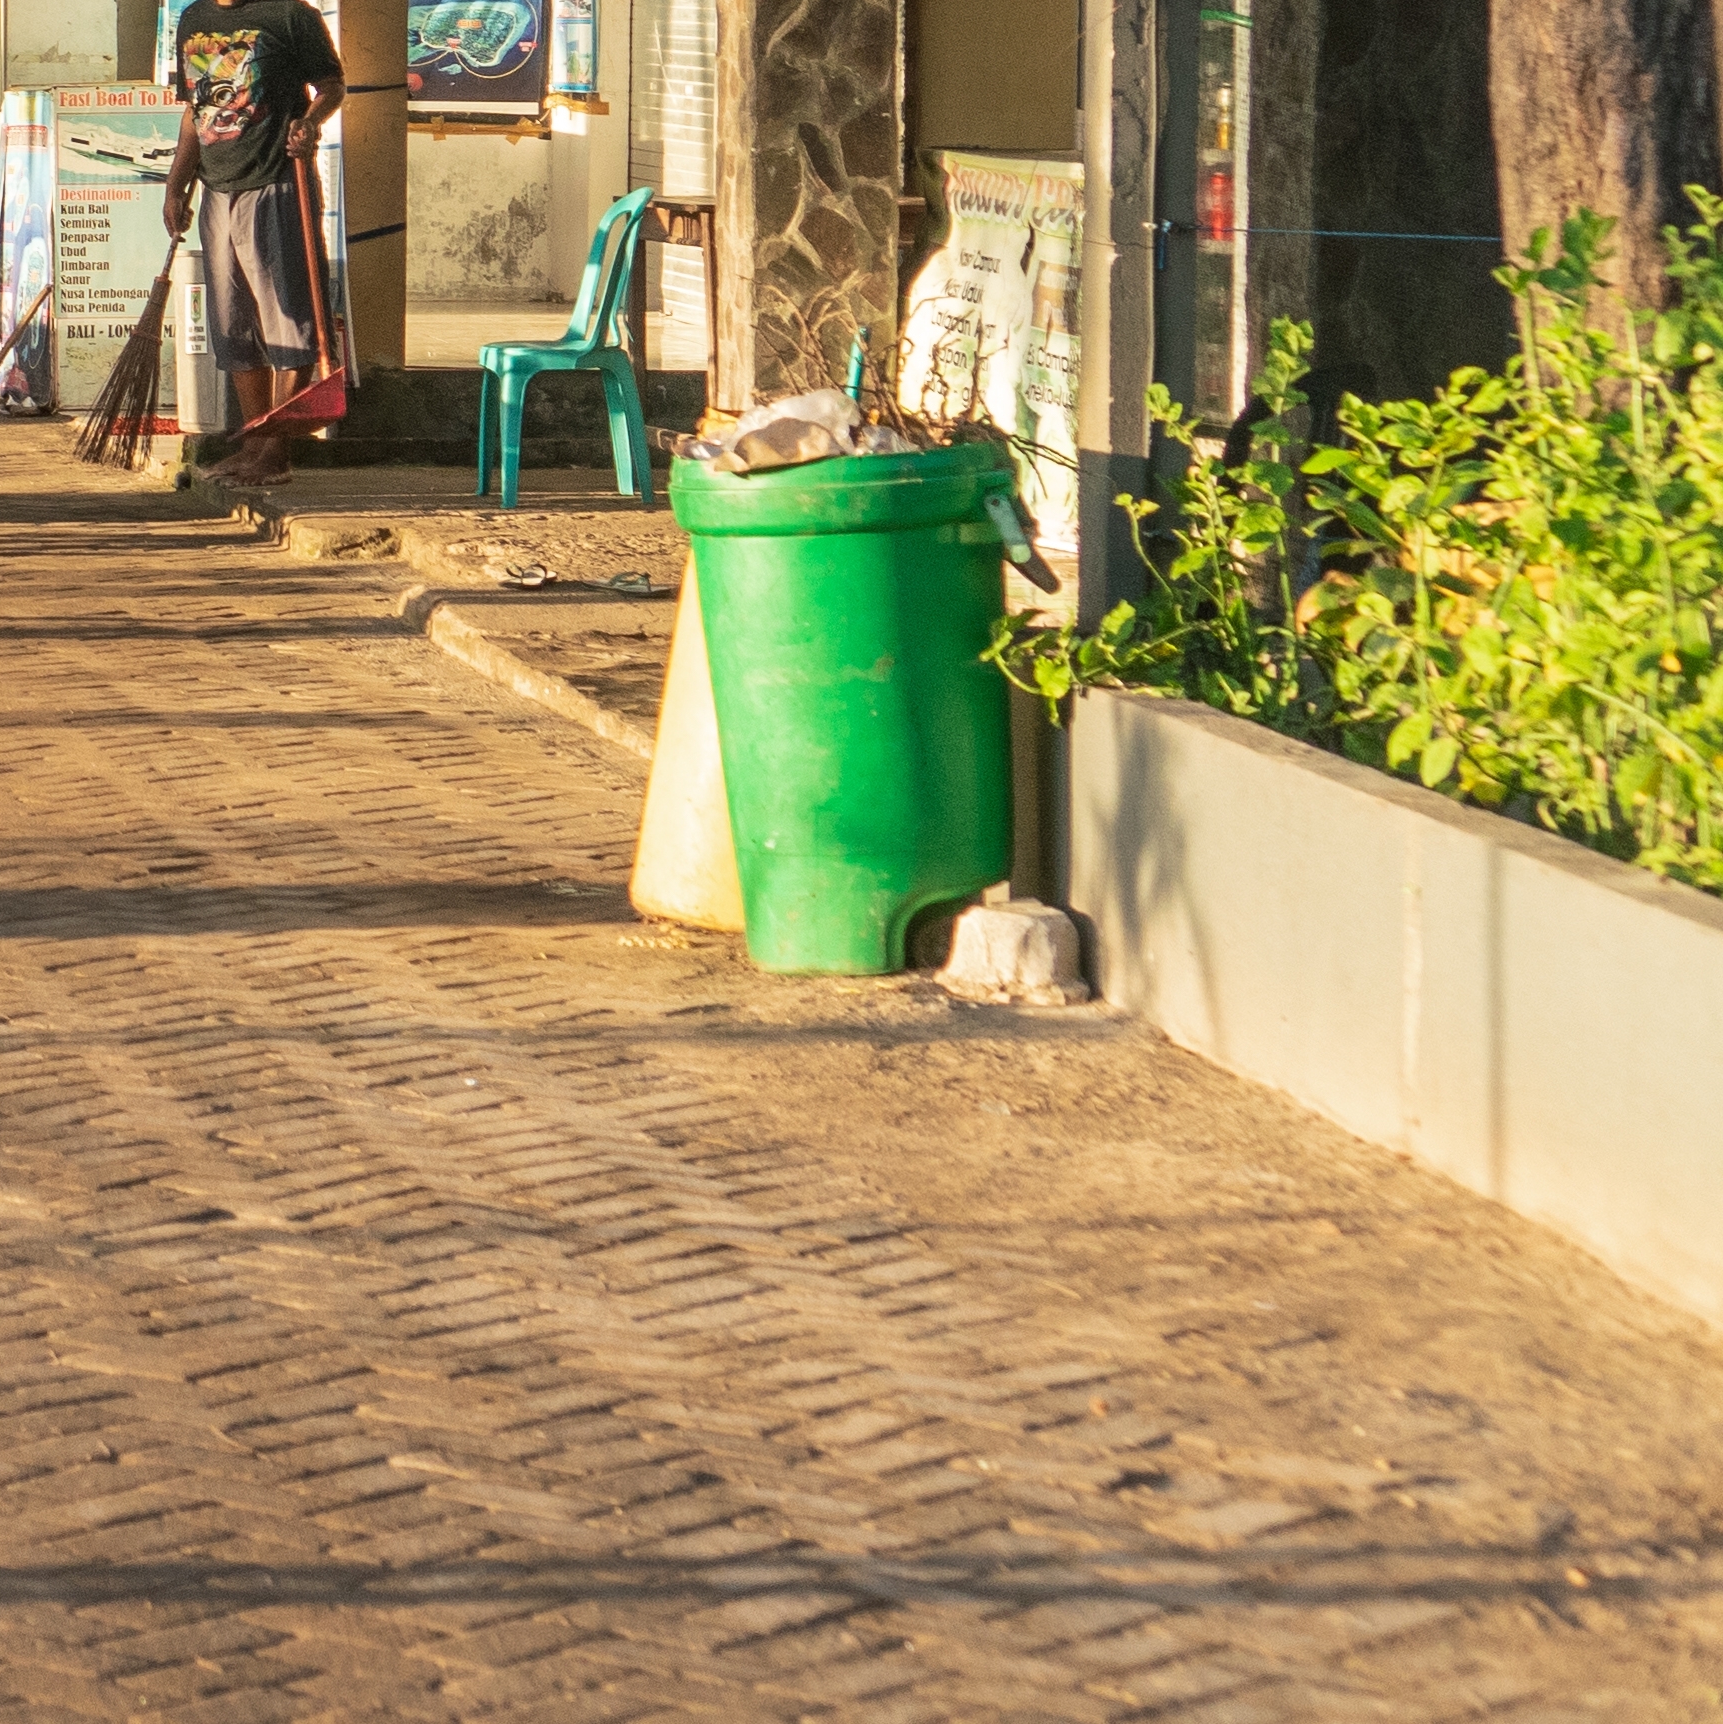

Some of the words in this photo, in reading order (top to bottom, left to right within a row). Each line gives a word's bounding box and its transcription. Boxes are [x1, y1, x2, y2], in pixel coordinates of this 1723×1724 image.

[59, 91, 91, 107] Fast
[96, 91, 136, 107] Boat
[138, 90, 158, 107] To
[60, 188, 132, 202] Destination
[60, 204, 86, 215] Kuta
[88, 204, 109, 215] Bali
[60, 218, 111, 230] Seminyak
[60, 232, 110, 245] Denpasar
[60, 246, 87, 257] Ubud
[60, 260, 110, 272] Jimbaran
[60, 274, 91, 285] Sanur
[60, 288, 86, 300] Nusa
[88, 288, 150, 300] Lembongan
[60, 302, 86, 314] Nusa
[88, 302, 126, 314] Penida
[67, 325, 96, 339] BALI
